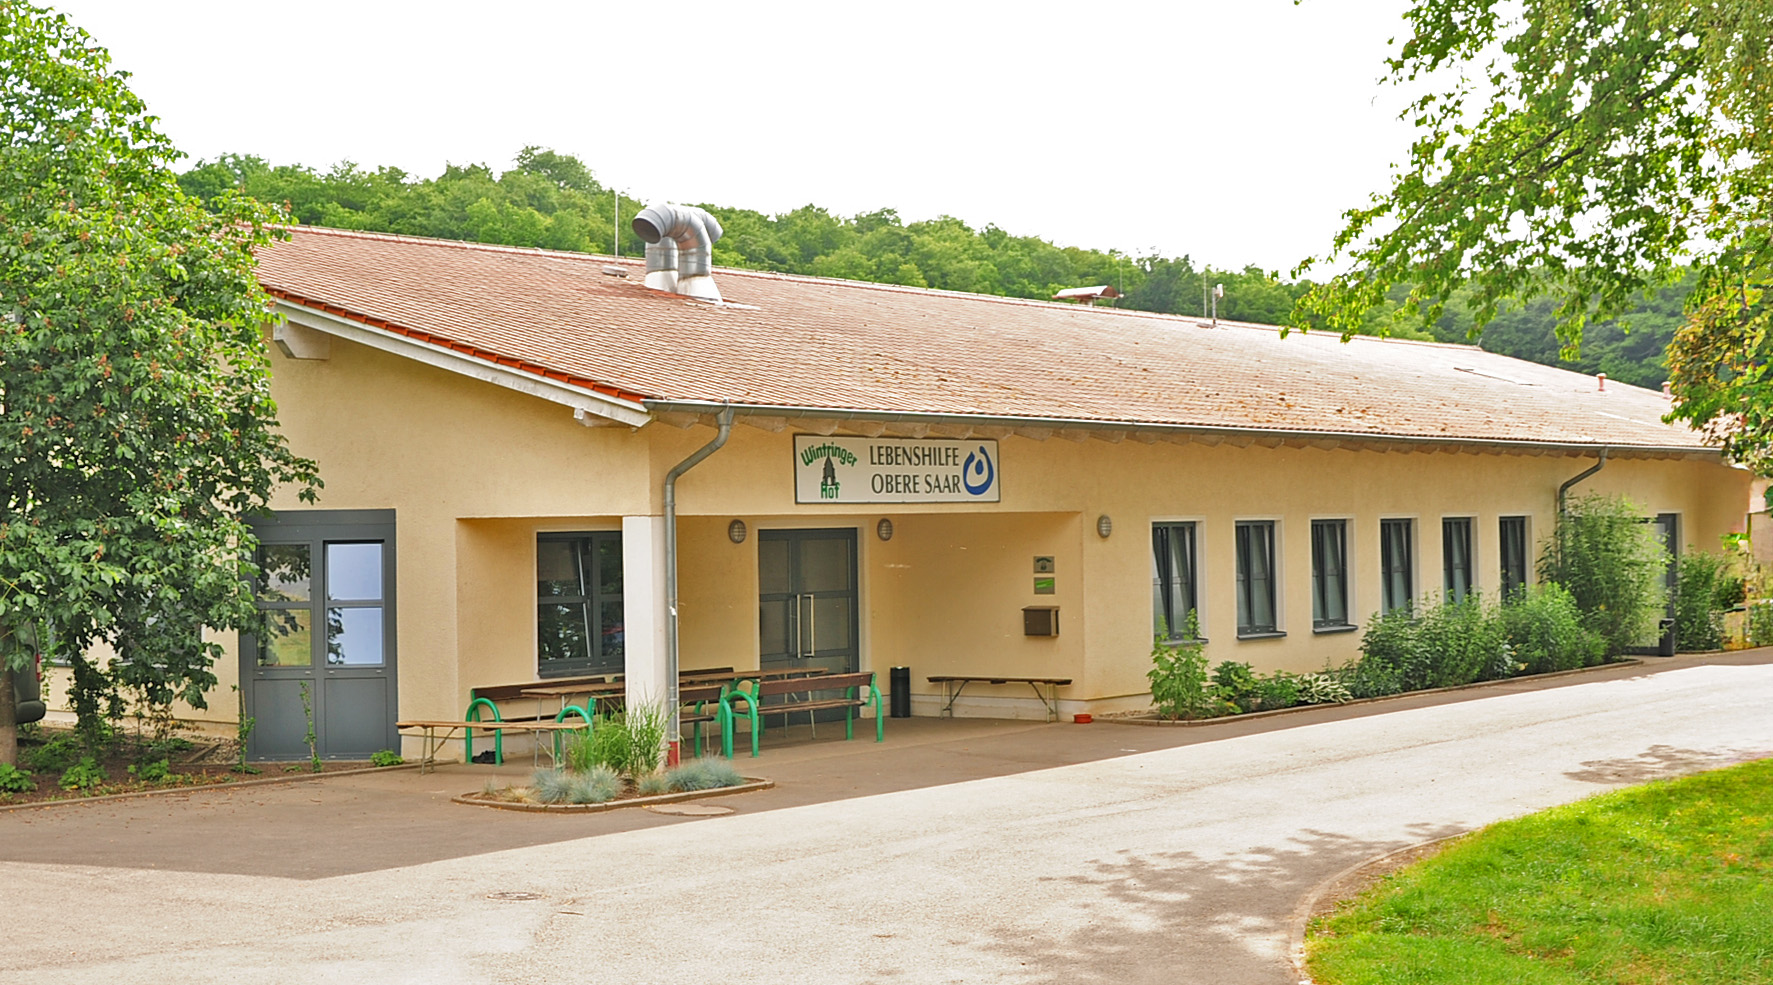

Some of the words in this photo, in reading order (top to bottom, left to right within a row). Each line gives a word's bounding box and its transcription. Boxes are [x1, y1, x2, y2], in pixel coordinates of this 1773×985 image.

[801, 442, 858, 467] Wintringer
[870, 445, 959, 466] LEBENSHILFE
[820, 482, 840, 499] Hof
[871, 473, 920, 494] OBERE
[924, 474, 961, 494] SAAR
